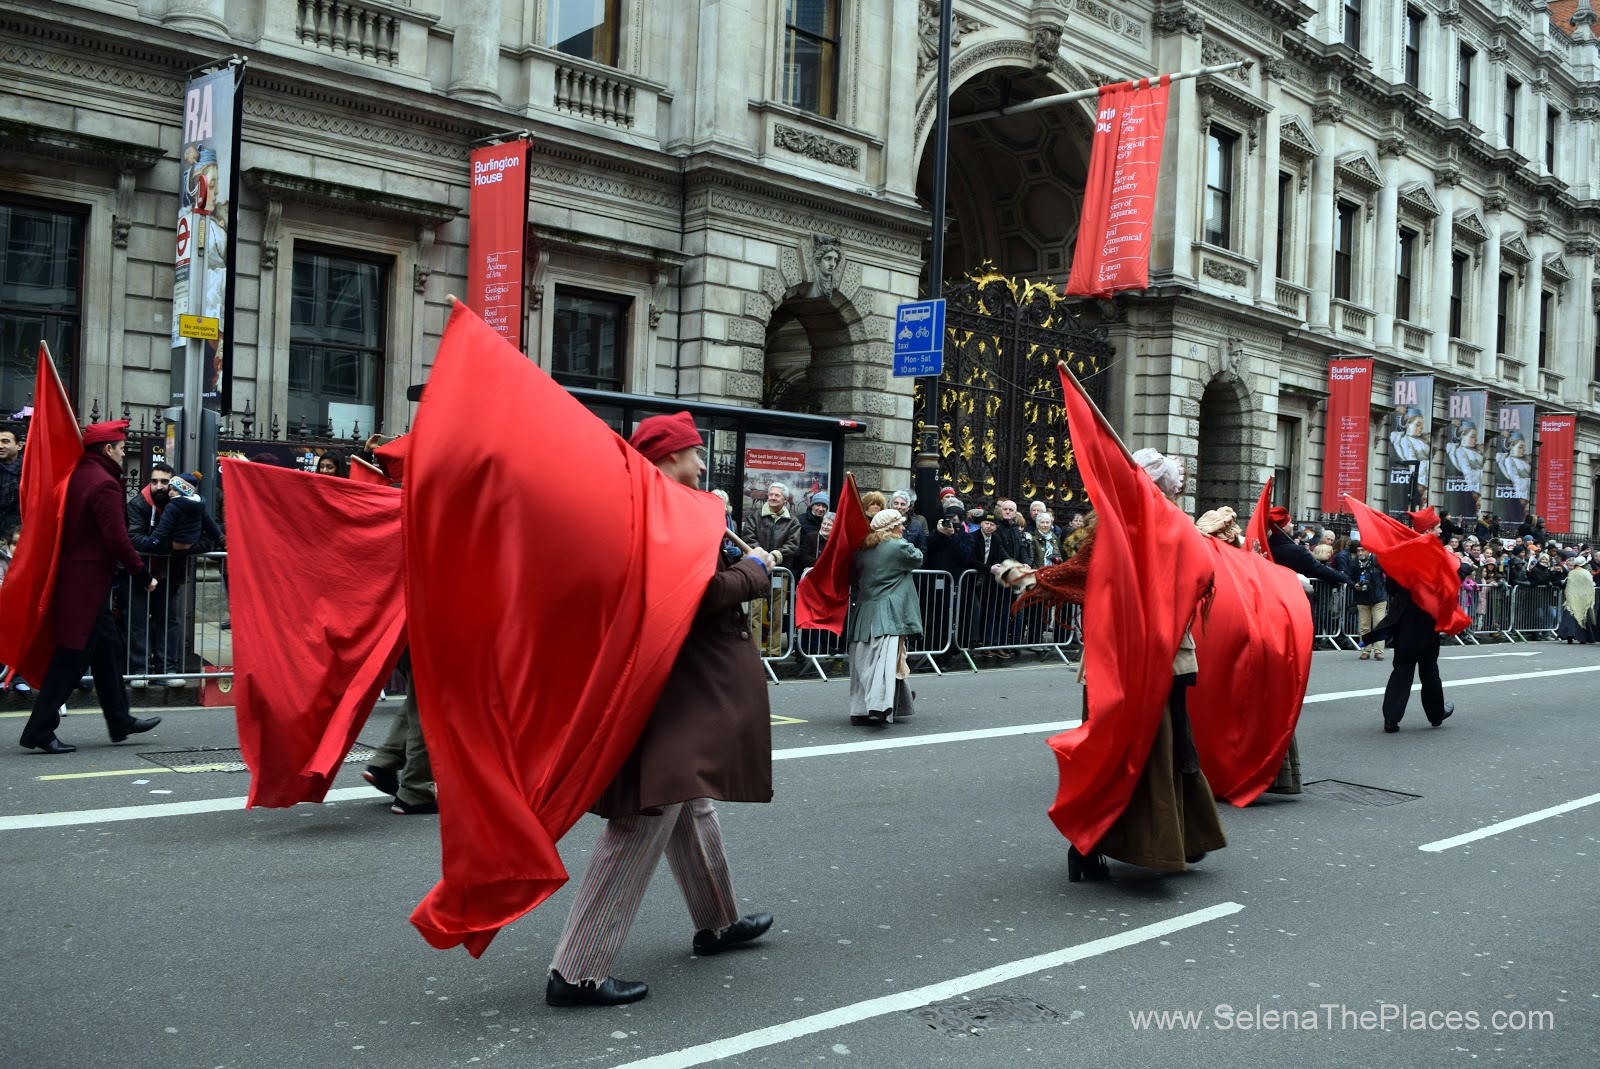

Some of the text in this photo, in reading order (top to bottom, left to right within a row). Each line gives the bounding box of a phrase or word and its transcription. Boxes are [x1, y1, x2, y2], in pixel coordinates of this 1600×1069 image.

[185, 84, 213, 144] RA
[475, 156, 519, 173] Burlington
[475, 172, 503, 186] House
[1331, 366, 1367, 375] Burlington
[1394, 381, 1418, 404] RA
[1449, 395, 1472, 418] RA
[1500, 408, 1520, 430] RA
[1446, 482, 1480, 492] Liotard
[1495, 489, 1528, 499] Liotard
